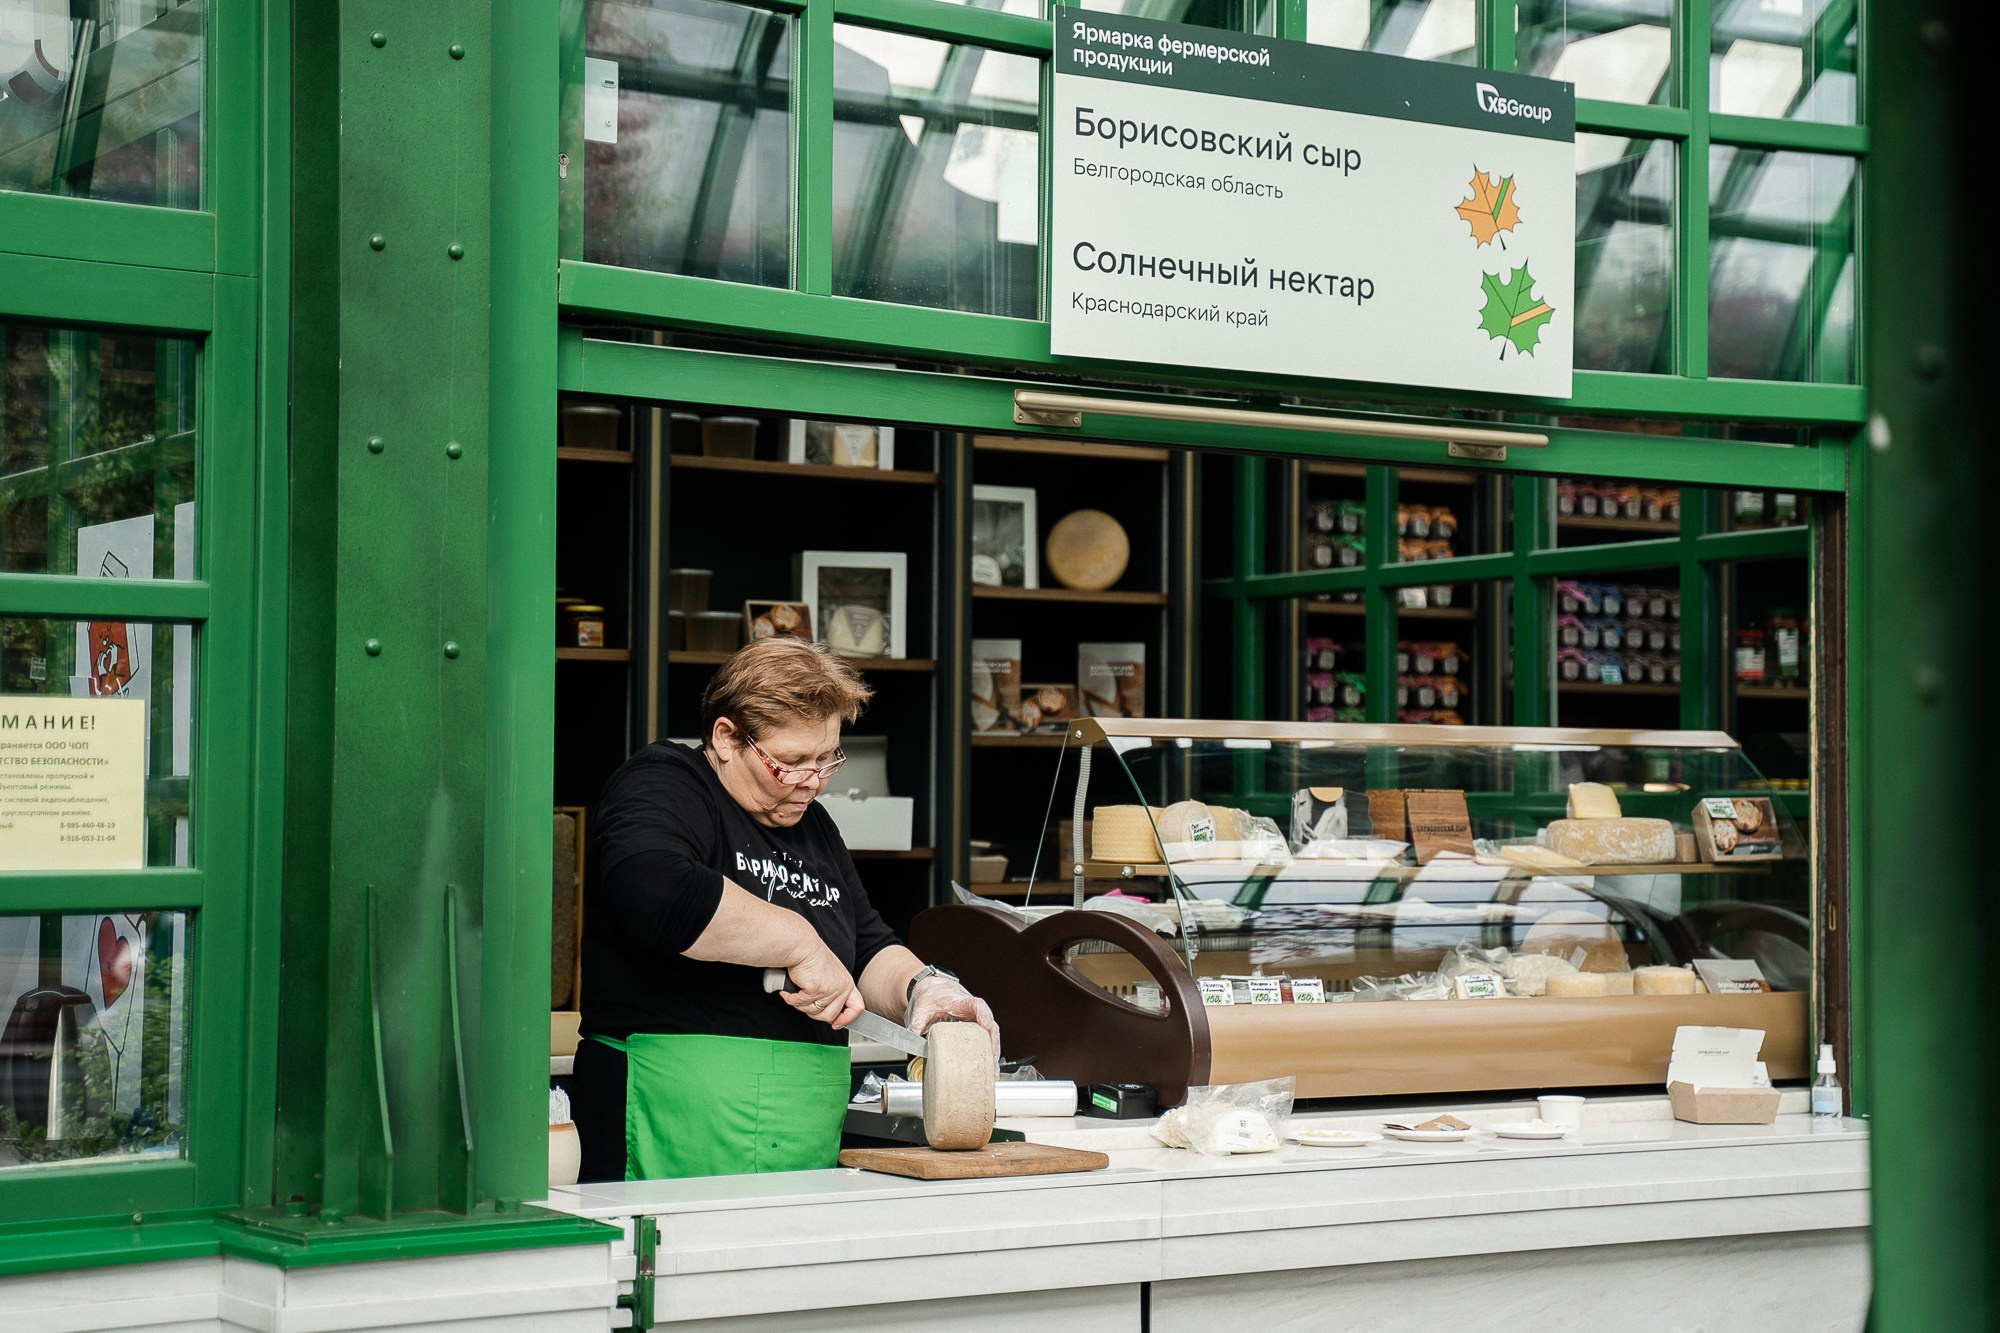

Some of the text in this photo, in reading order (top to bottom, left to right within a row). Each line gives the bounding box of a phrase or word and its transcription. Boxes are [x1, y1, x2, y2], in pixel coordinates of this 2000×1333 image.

[1073, 21, 1271, 67] Ярмарка фермерской
[1073, 48, 1174, 75] продукции
[1075, 106, 1362, 177] Борисовский сыр
[1073, 157, 1284, 199] Белгородская область
[1073, 241, 1376, 306] Солнечный нектар
[1072, 291, 1269, 328] Краснодарский край
[45, 741, 67, 750] ООО
[69, 741, 89, 750] ЧОП
